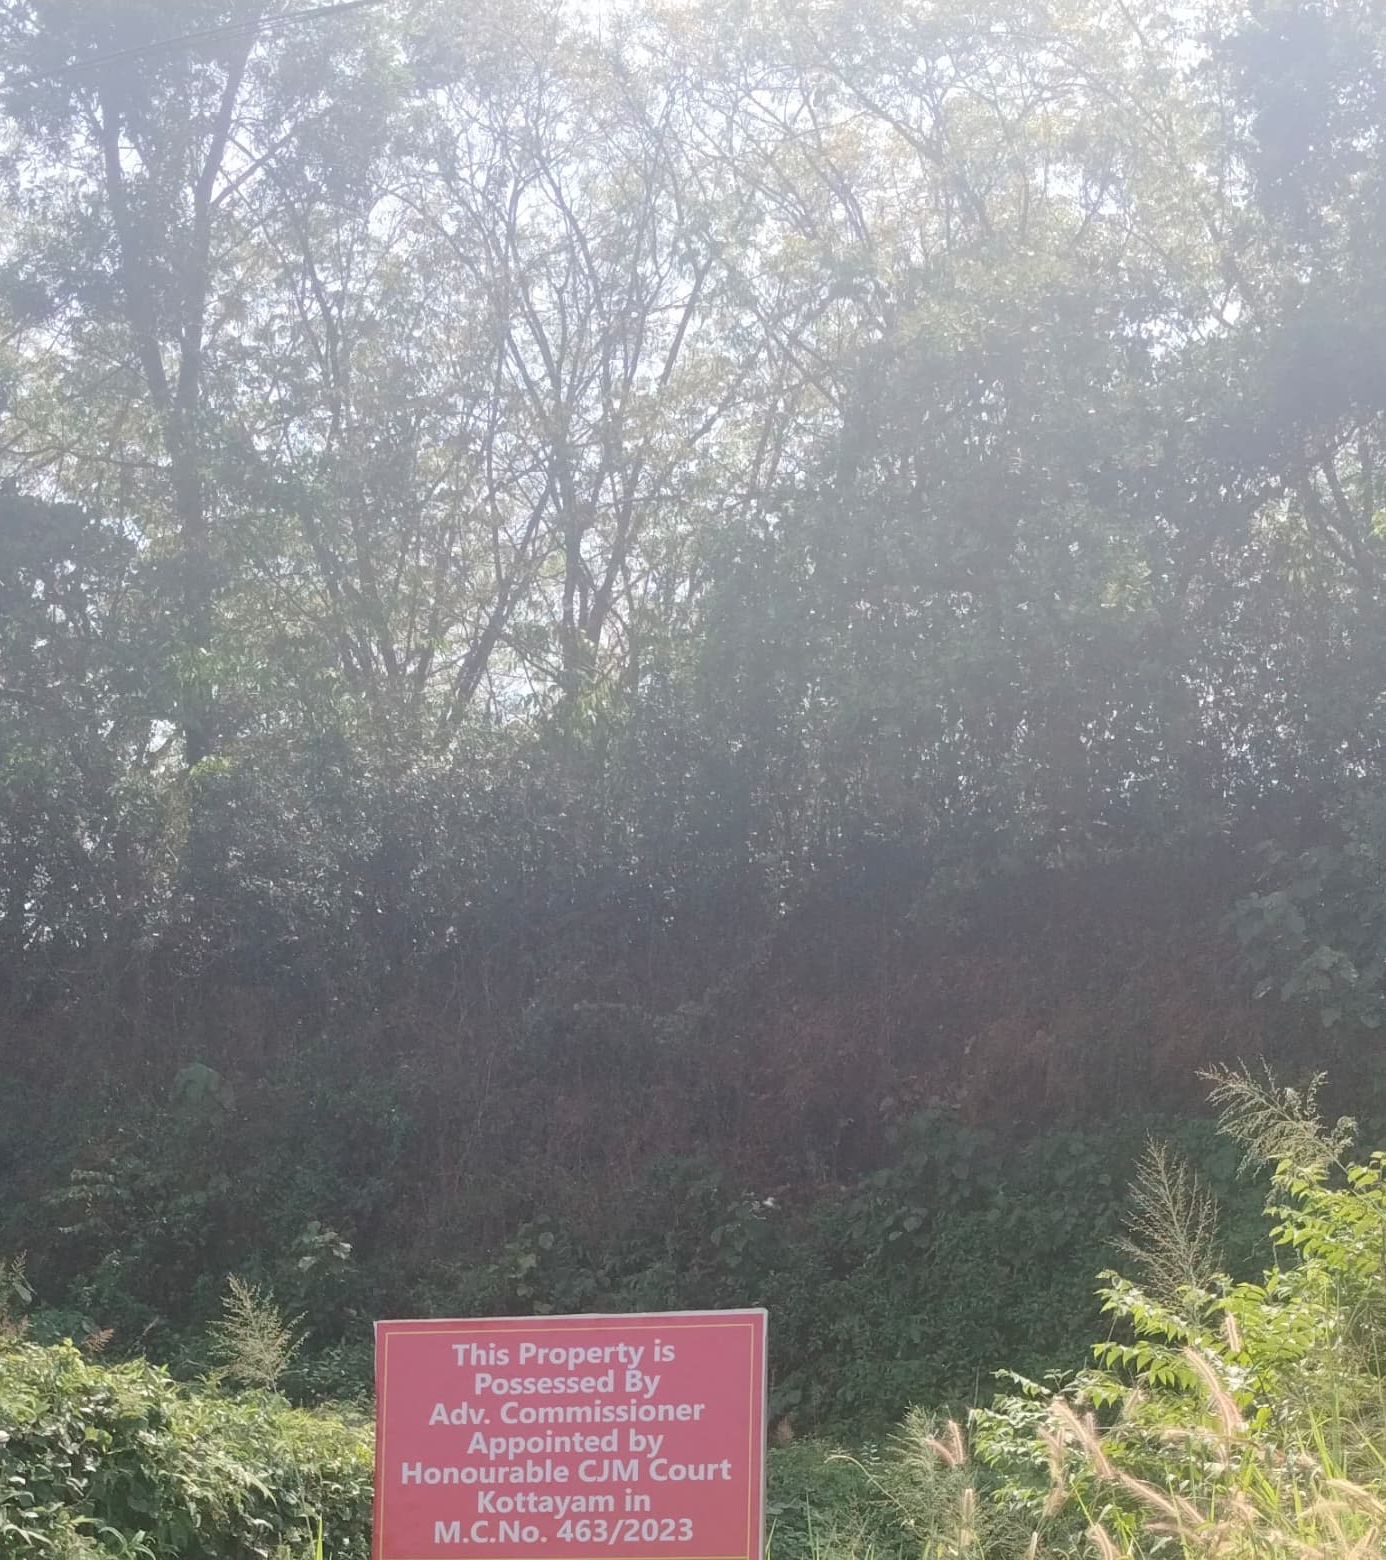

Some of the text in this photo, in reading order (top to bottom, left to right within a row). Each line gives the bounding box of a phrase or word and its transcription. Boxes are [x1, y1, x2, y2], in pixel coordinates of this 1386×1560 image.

[452, 1340, 675, 1370] This Property is
[475, 1369, 660, 1398] Possessed By
[429, 1400, 705, 1425] Adv. Commissioner
[467, 1429, 664, 1460] Appointed by
[401, 1458, 732, 1485] Honourable CJM Court
[477, 1488, 651, 1519] Kottayam in
[433, 1519, 693, 1545] M.C.No. 463/2023
